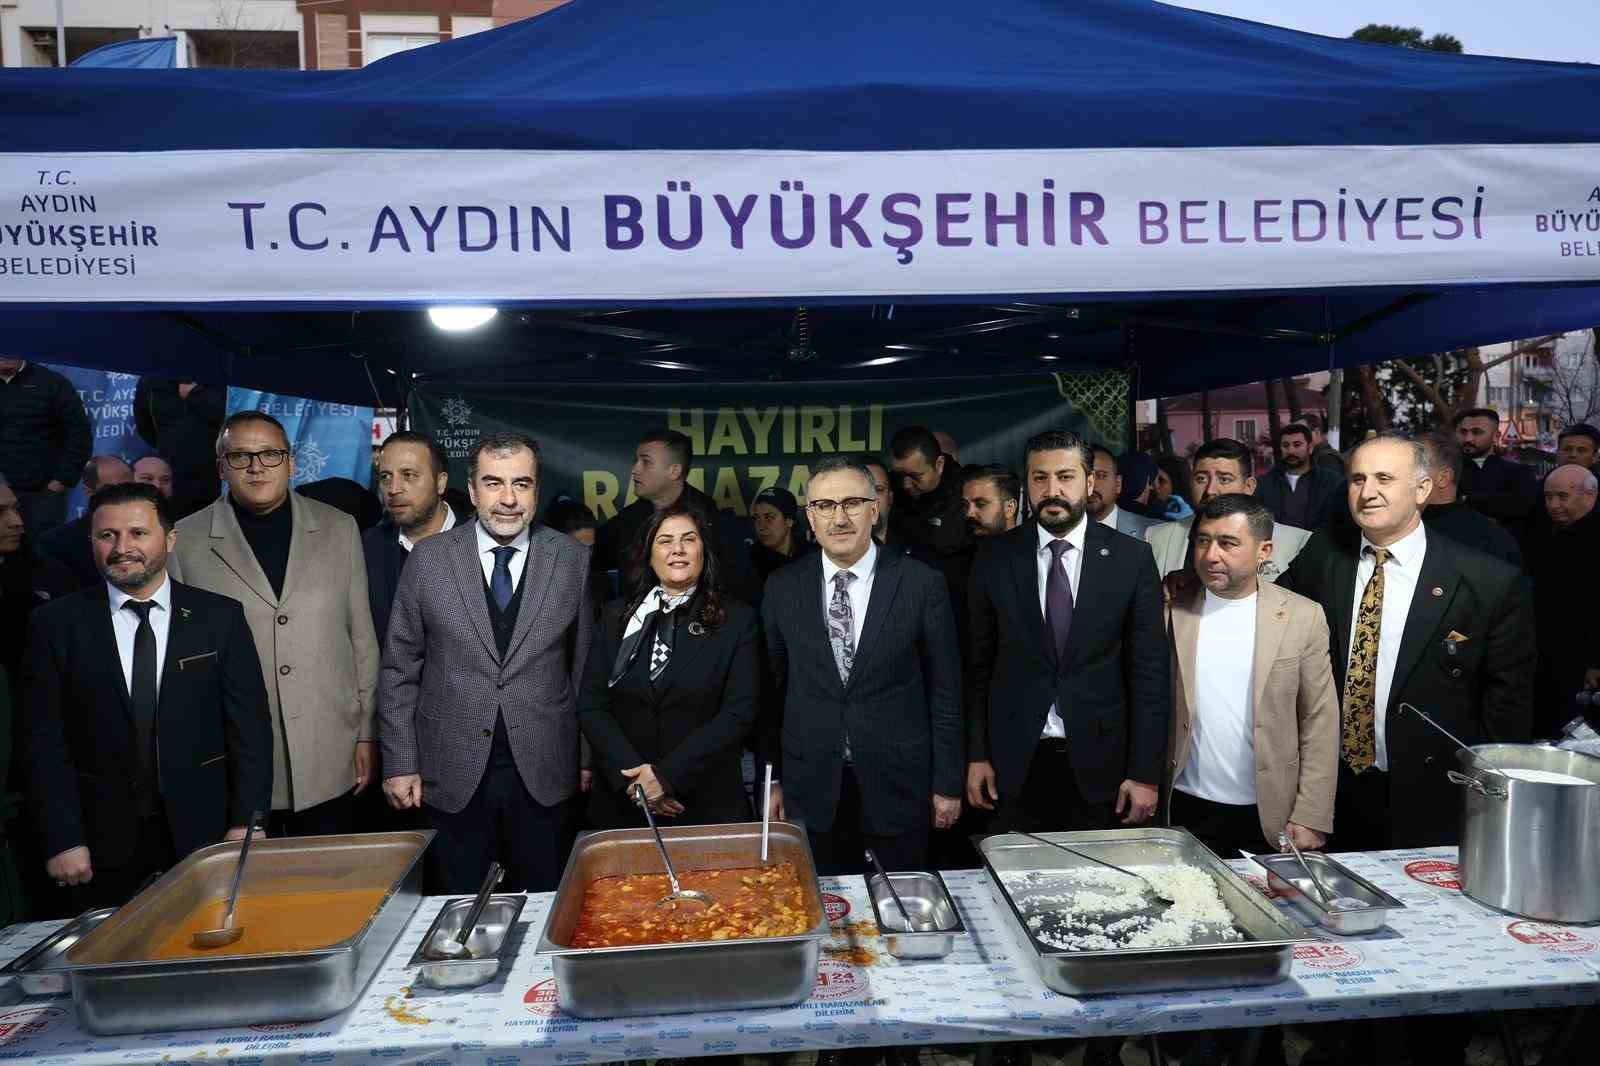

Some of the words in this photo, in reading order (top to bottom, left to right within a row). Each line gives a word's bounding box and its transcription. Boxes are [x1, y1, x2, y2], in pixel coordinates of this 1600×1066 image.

[37, 170, 77, 186] T.C.
[20, 194, 97, 213] AYDIN
[227, 201, 350, 251] T.C.
[367, 204, 572, 253] AYDIN
[603, 178, 1109, 265] BÜYÜKŞEHİR
[1138, 186, 1485, 245] BELEDİYESİ
[0, 220, 159, 252] YÜKŞEHİR
[1560, 240, 1600, 257] BEL
[668, 404, 884, 455] HAYIRLI
